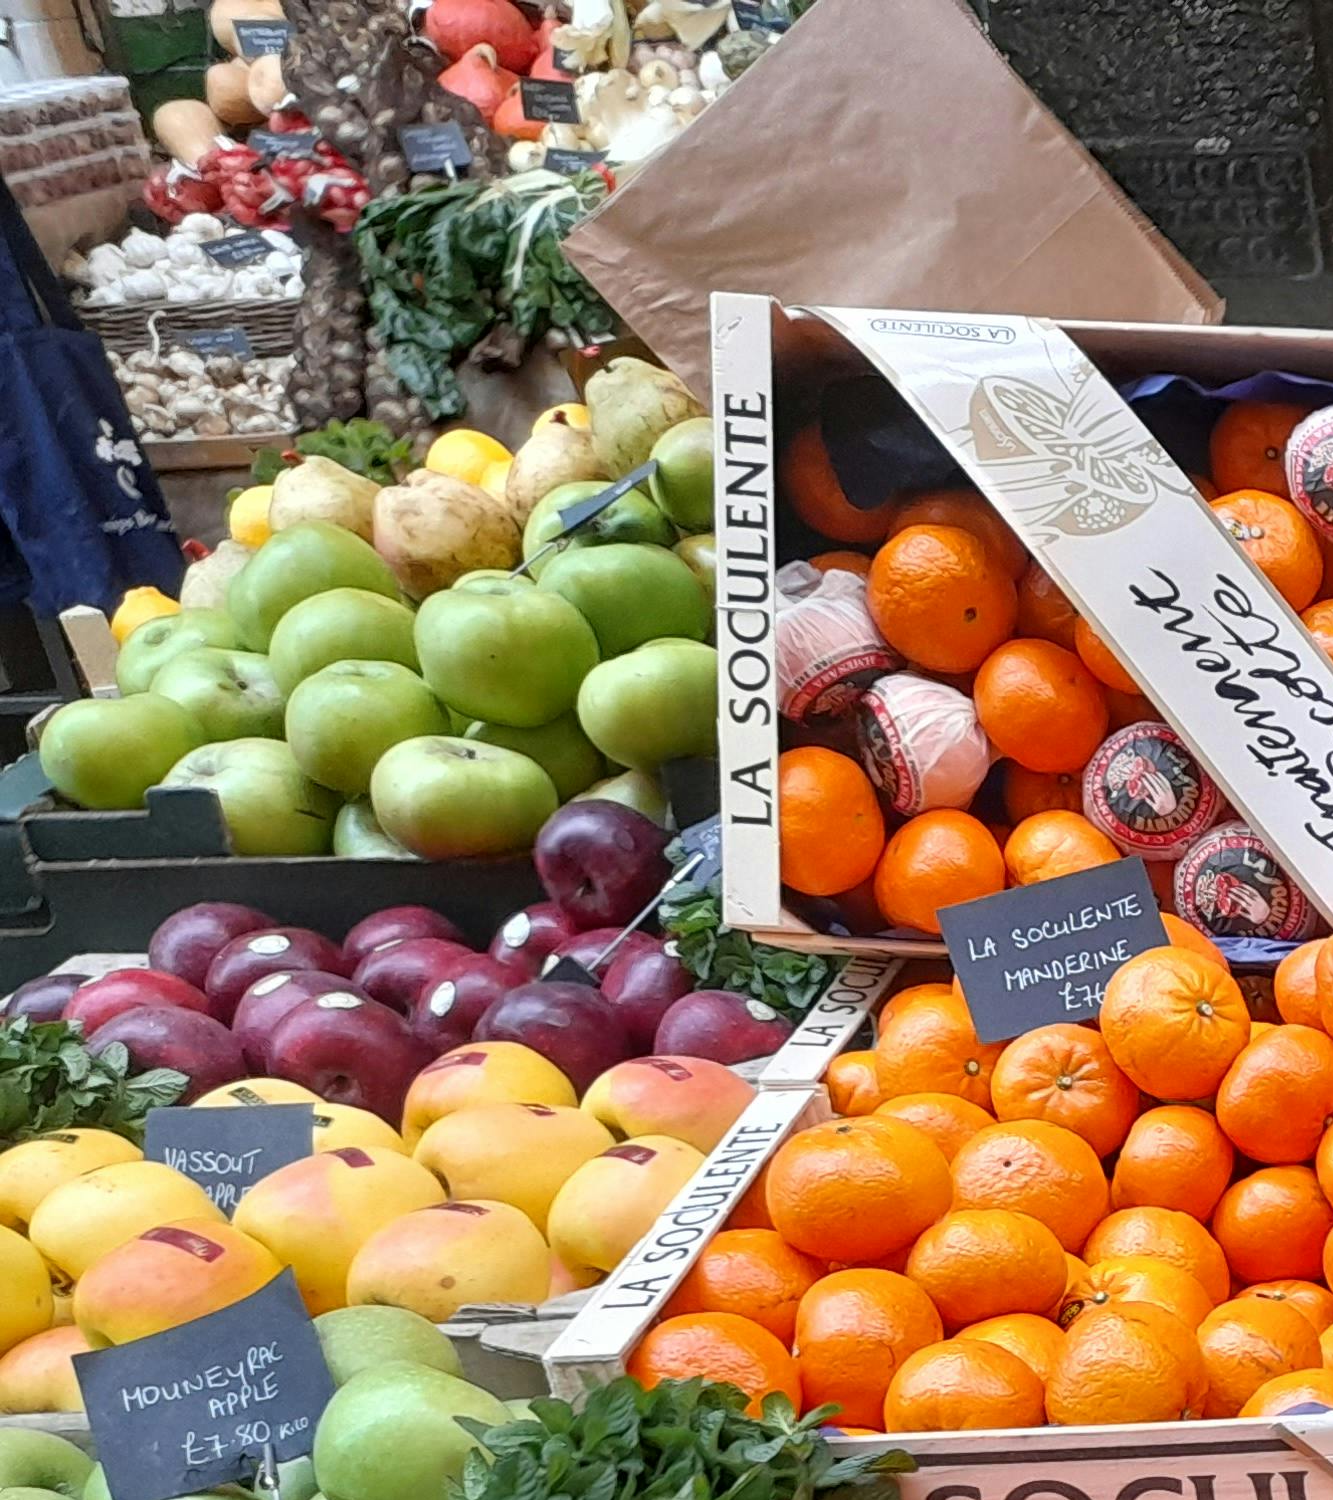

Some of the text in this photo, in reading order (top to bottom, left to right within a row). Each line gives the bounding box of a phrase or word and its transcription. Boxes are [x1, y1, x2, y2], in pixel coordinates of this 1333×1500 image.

[879, 320, 1010, 341] LA SOCULENTE
[724, 391, 772, 827] LA SOCULENTE
[968, 894, 1143, 961] LA SOCULENTE
[1003, 939, 1133, 992] MANDERINE
[791, 1025, 844, 1047] LA
[165, 1147, 262, 1176] VASSOUT
[602, 1122, 783, 1309] LA SOCULENTE
[122, 1342, 284, 1413] MOUNEYRAC
[209, 1374, 280, 1418] APPLE
